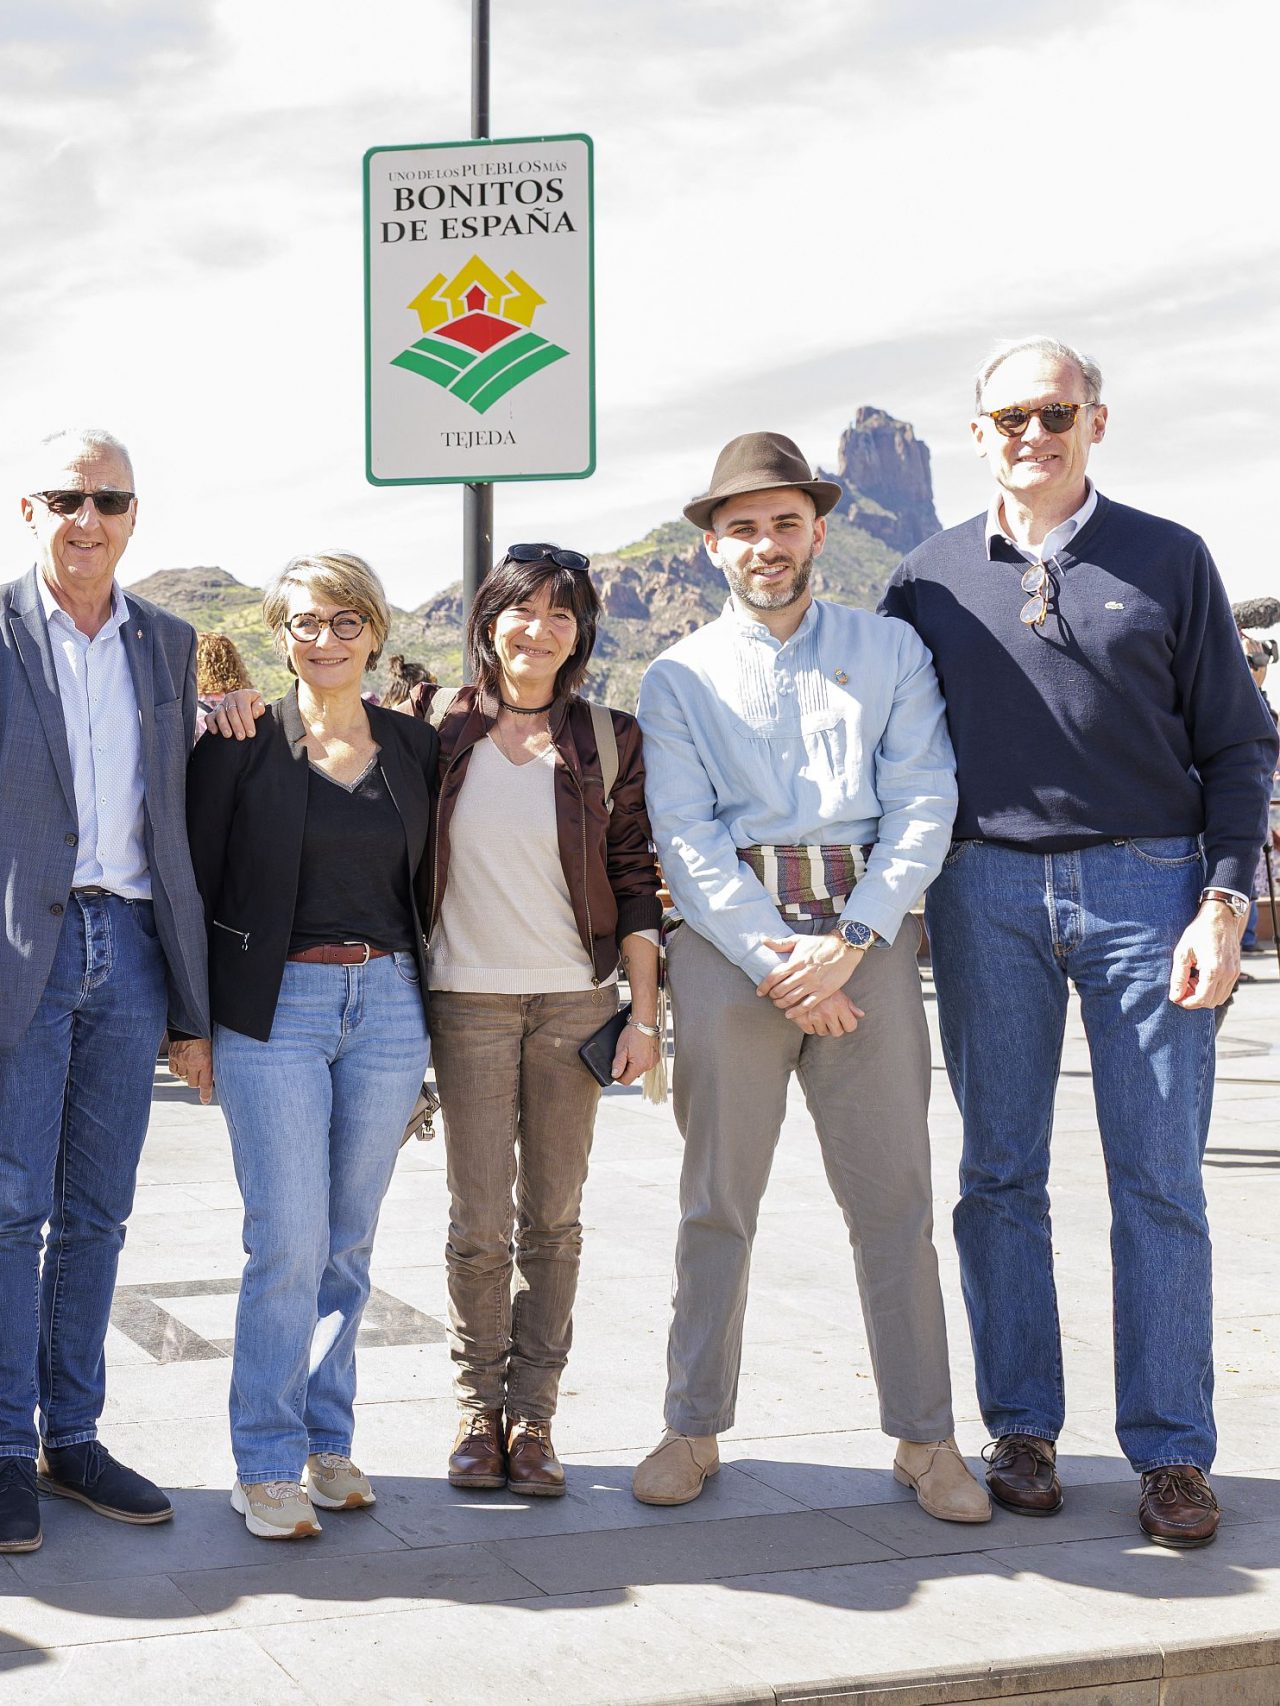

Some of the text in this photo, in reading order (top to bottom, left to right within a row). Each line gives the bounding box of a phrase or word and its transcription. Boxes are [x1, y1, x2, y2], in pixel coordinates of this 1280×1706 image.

[388, 159, 567, 182] UNO DE LOS PUEBLOS MÁS
[393, 178, 564, 212] BONITOS
[381, 207, 578, 243] DE ESPAÑA
[441, 430, 517, 449] TEJEDA
